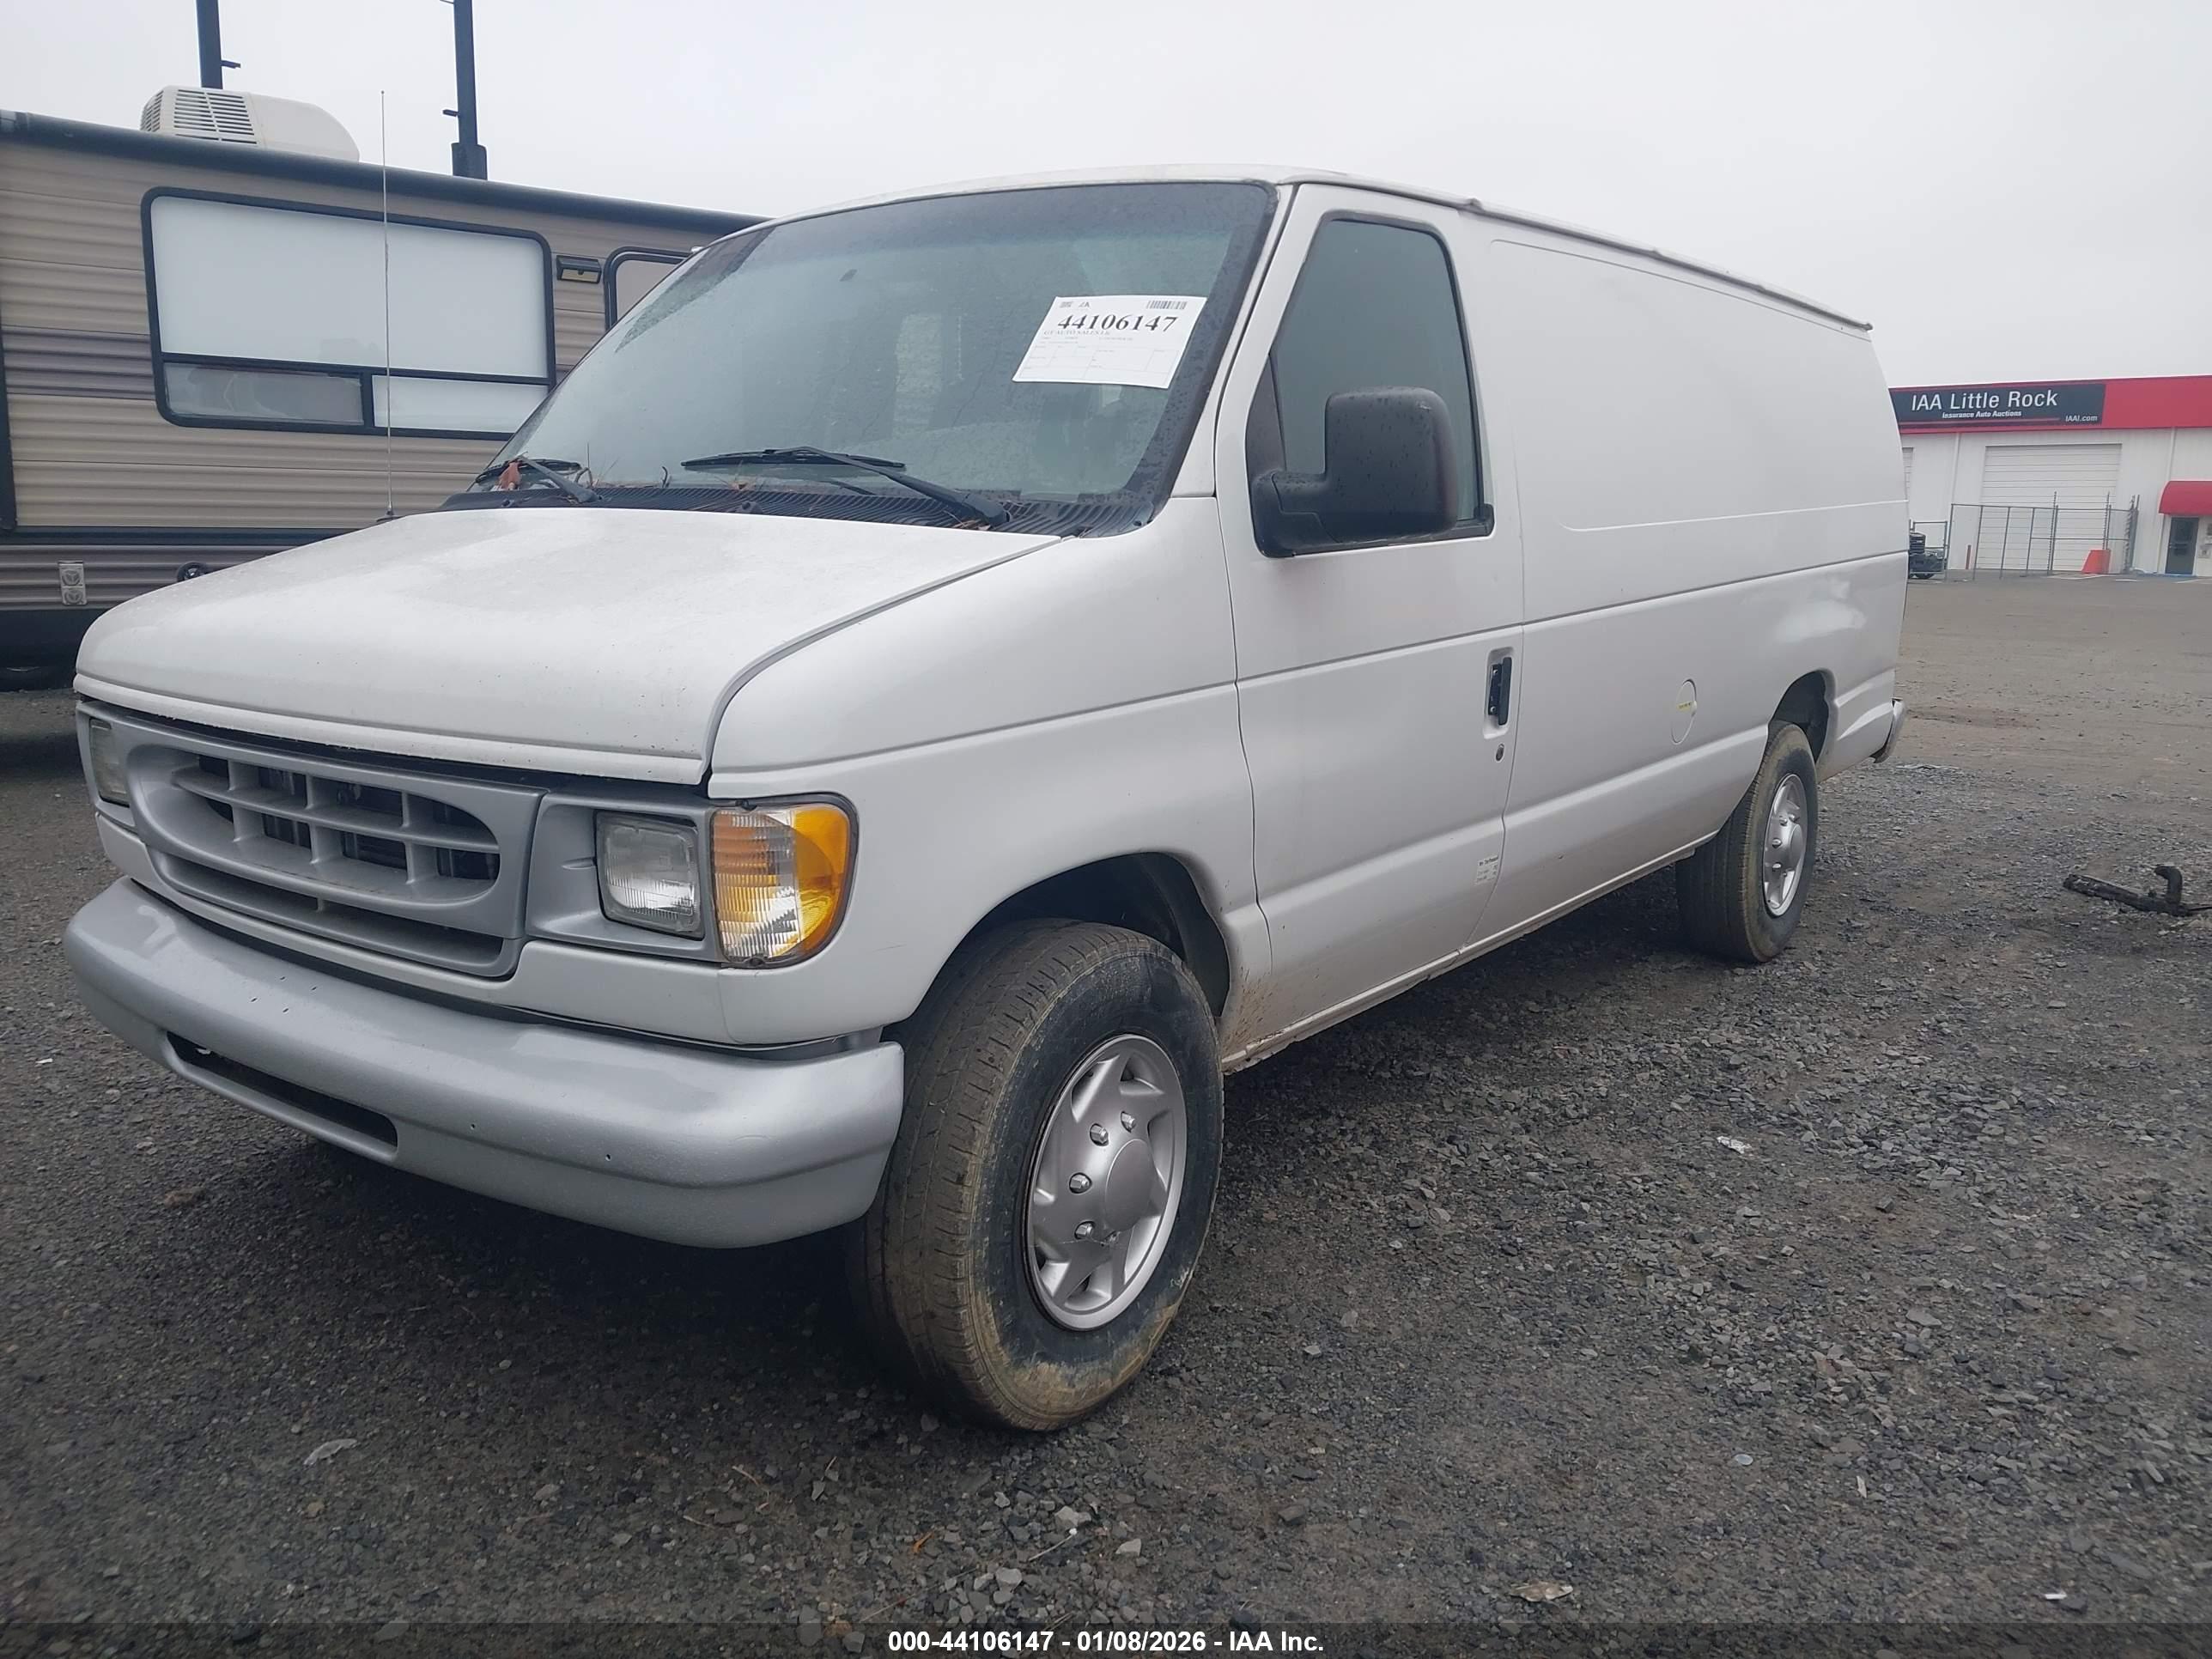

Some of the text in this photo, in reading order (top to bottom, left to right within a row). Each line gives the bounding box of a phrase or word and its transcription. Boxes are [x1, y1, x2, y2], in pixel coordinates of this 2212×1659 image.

[1057, 313, 1179, 332] 44106147
[1911, 389, 2059, 411] IAA Little Rock
